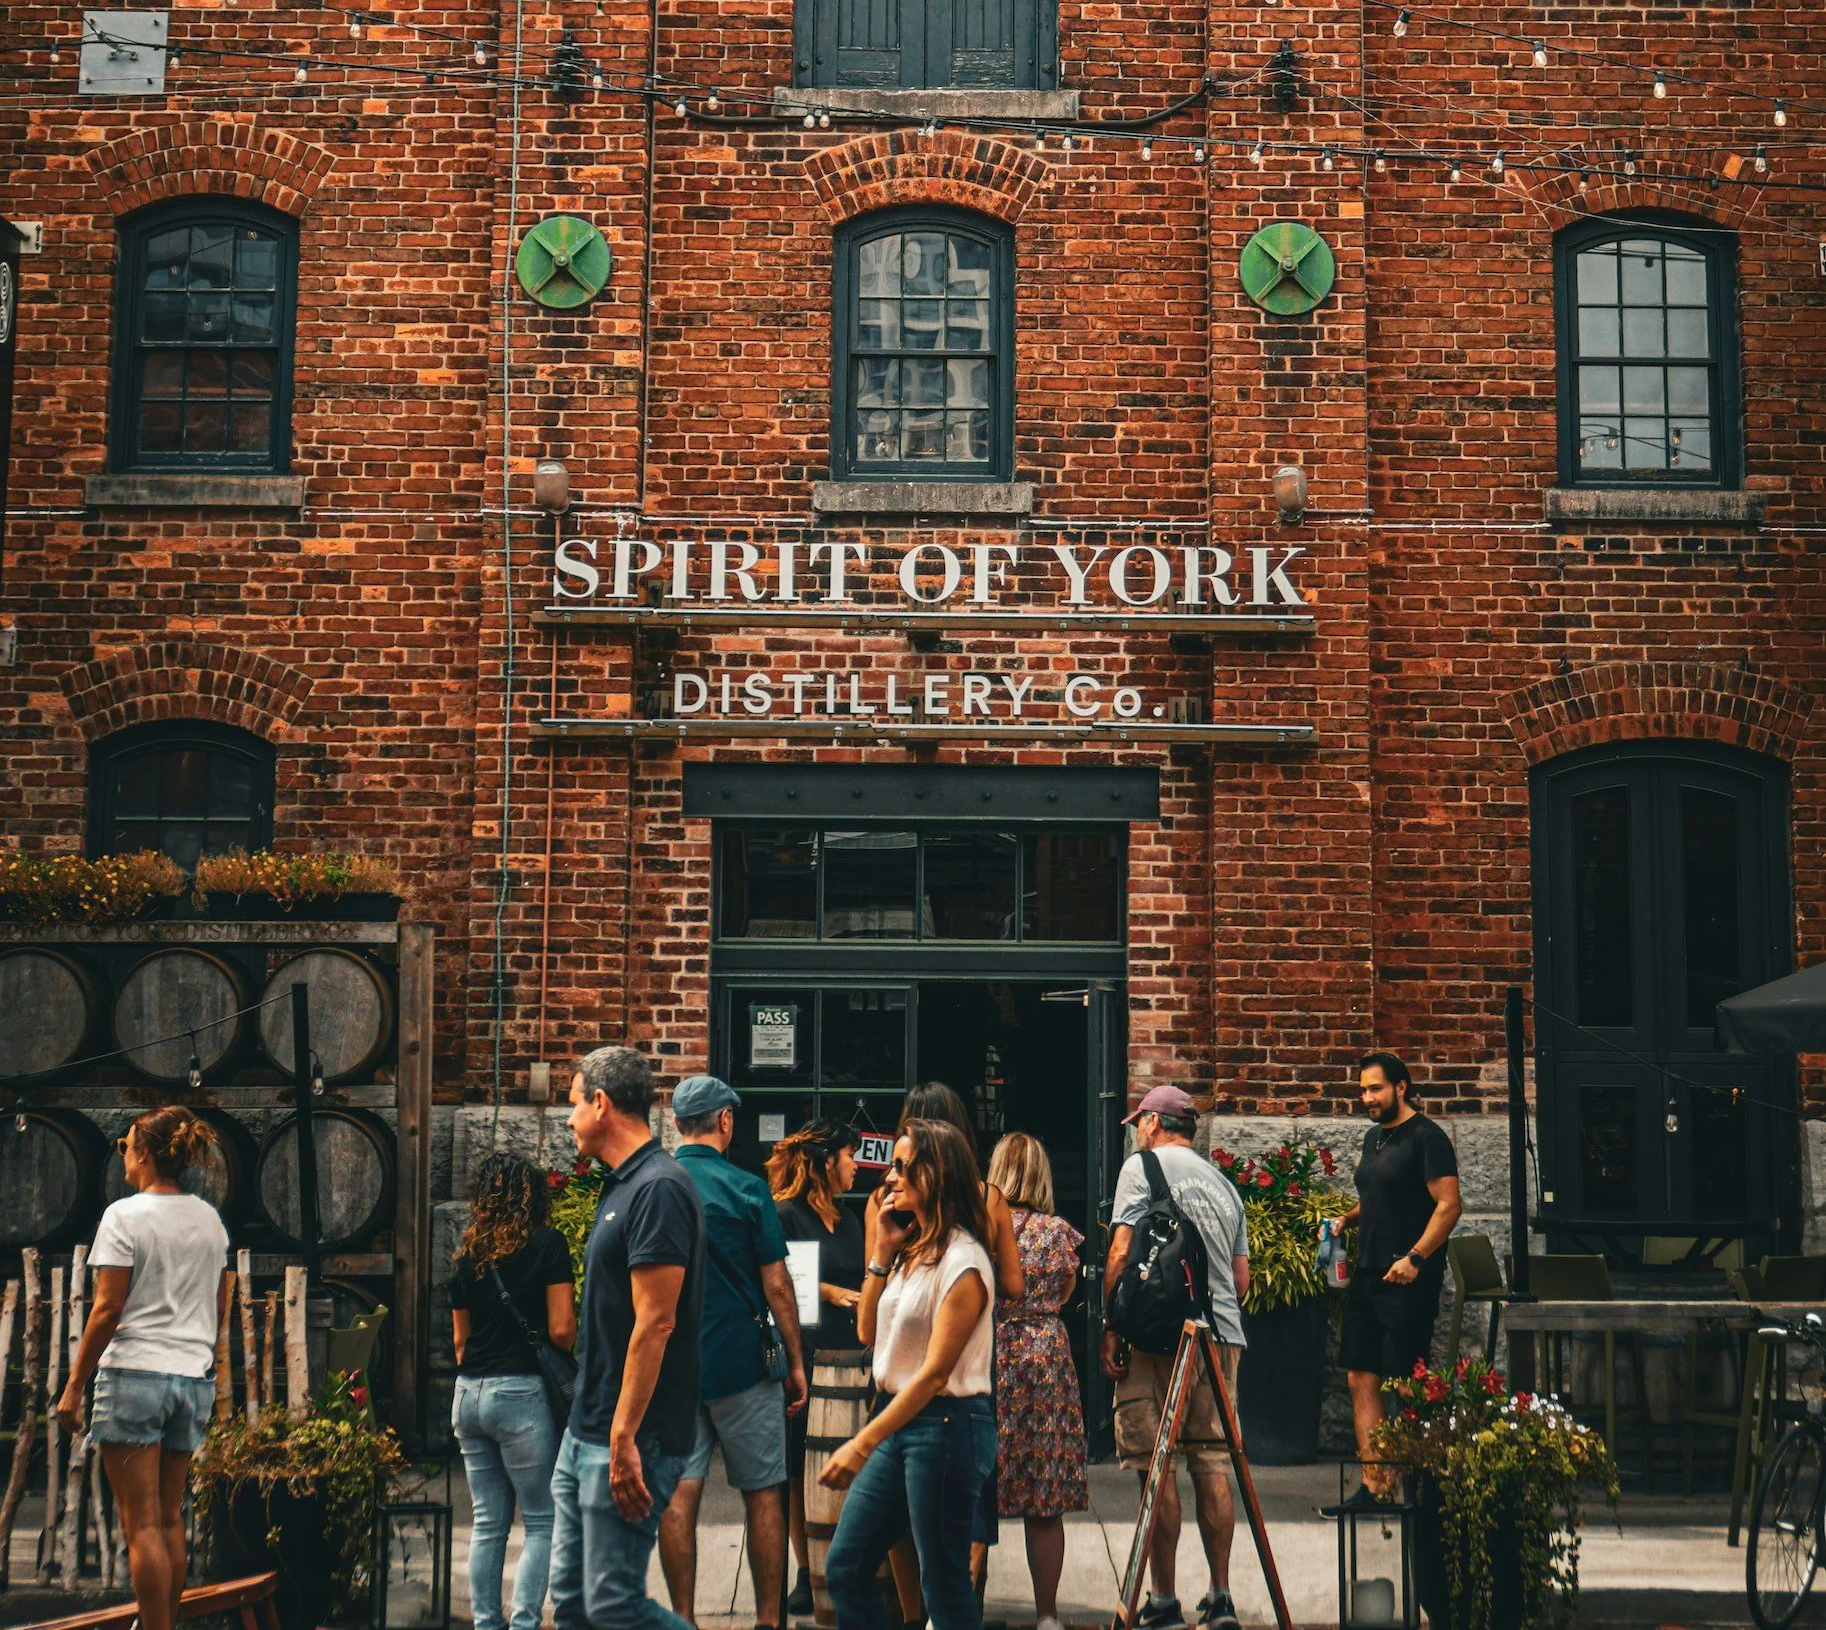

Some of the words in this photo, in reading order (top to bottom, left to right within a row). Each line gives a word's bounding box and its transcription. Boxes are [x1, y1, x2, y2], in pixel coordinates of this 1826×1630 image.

[553, 538, 867, 601] SPIRIT
[898, 543, 1020, 604] OF
[1047, 544, 1309, 606] YORK
[674, 672, 1034, 716] DISTILLERY
[1064, 675, 1164, 718] Co.
[756, 1011, 790, 1025] PASS
[862, 1139, 888, 1162] EN
